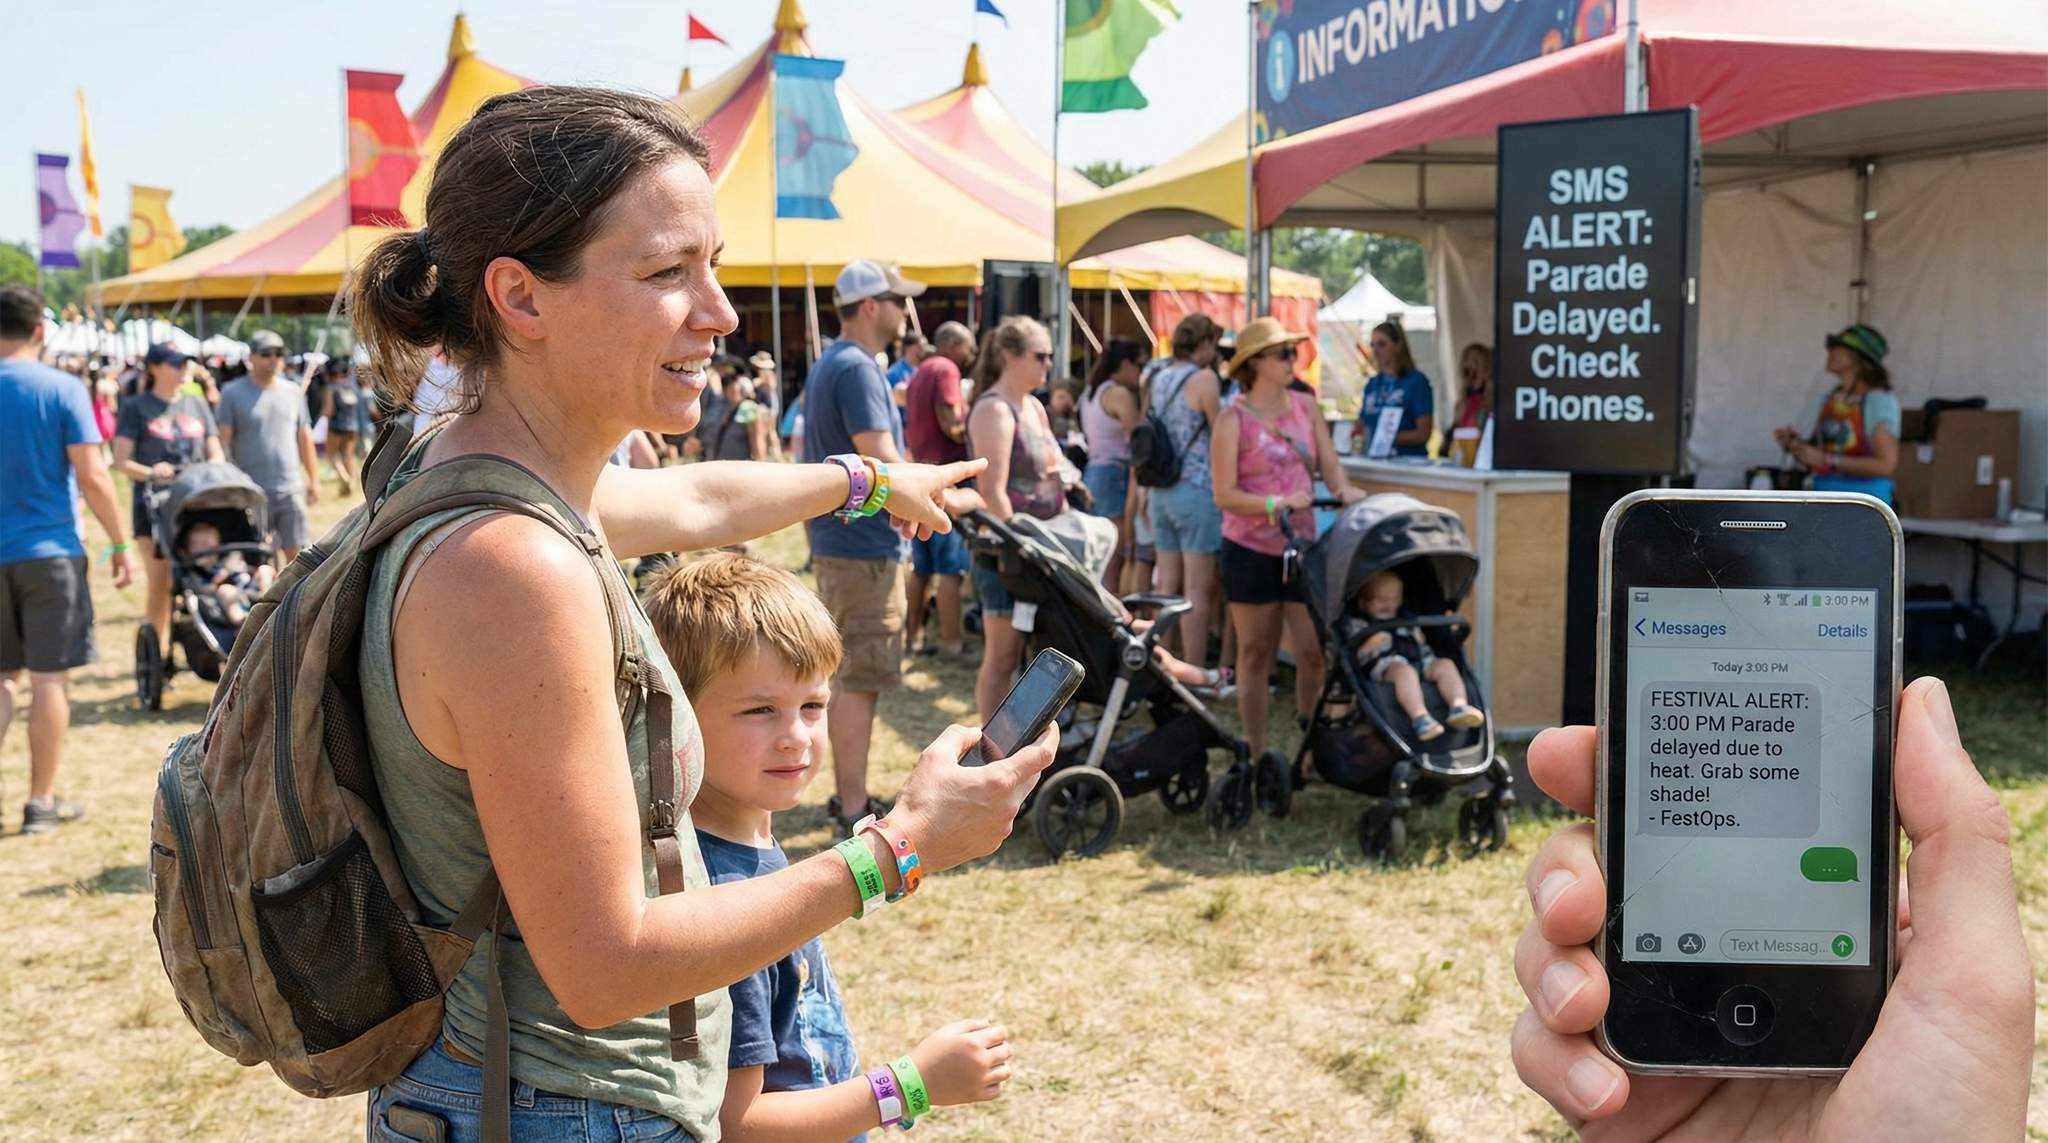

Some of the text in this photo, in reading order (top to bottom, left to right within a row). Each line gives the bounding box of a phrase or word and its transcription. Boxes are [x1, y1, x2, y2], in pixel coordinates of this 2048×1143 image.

[1549, 165, 1629, 205] SMS
[1522, 210, 1653, 250] ALERT:
[1527, 255, 1648, 293] Parade
[1512, 299, 1661, 342] Delayed.
[1530, 344, 1641, 379] Check
[1515, 387, 1654, 422] Phones.
[1850, 595, 1869, 606] PM
[1651, 621, 1727, 638] Messages
[1817, 623, 1868, 637] Details
[1711, 661, 1743, 675] Today
[1771, 662, 1789, 673] PM
[1651, 690, 1809, 709] FESTIVAL ALERT:
[1650, 714, 1795, 732] 3:00 PM Parade
[1650, 738, 1783, 759] delayed due to
[1650, 762, 1800, 780] heat. Grab some
[1649, 785, 1711, 802] shade!
[1660, 810, 1741, 830] FestOps.
[1729, 938, 1760, 952] Text
